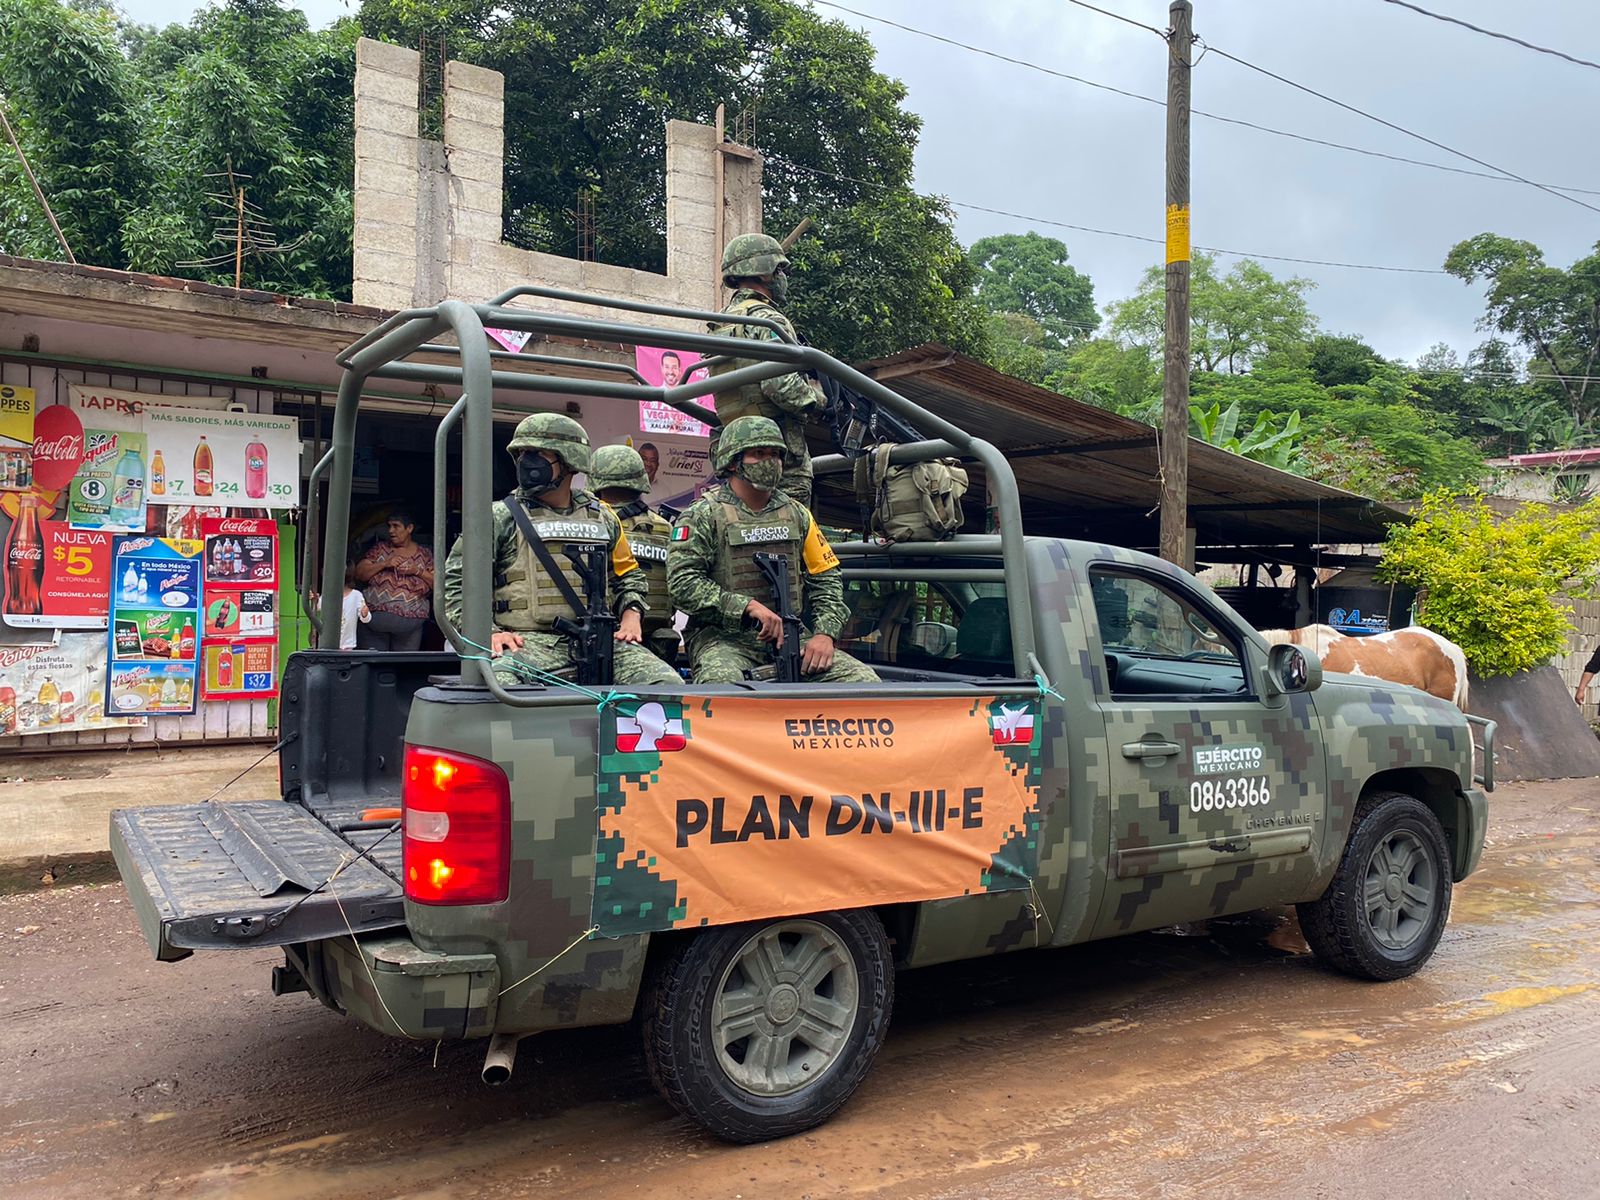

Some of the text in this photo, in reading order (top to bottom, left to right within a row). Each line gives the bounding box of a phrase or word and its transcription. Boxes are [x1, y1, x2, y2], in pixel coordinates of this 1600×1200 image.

[151, 413, 291, 430] MÁS SABORES, MÁS VARIEDAD
[647, 410, 670, 420] VEGA
[650, 423, 674, 431] XALAPA
[168, 480, 184, 491] $7
[215, 482, 239, 493] $24
[268, 484, 292, 495] $30
[219, 520, 259, 532] Coca-Cola
[538, 521, 599, 533] EJÉRCITO
[741, 526, 789, 537] EJÉRCITO
[54, 532, 107, 545] NUEVA
[745, 533, 789, 542] MEXICANO
[629, 541, 667, 560] ÉRCITO
[53, 545, 93, 575] $5
[254, 568, 272, 577] $20
[248, 674, 266, 687] $32
[785, 713, 895, 738] EJÉRCITO
[792, 737, 894, 750] MEXICANO
[1196, 747, 1263, 765] EJÉRCITO
[1199, 760, 1261, 773] MEXICANO
[1190, 776, 1271, 812] 0863366
[675, 787, 984, 848] PLAN DN-III-E
[1246, 813, 1312, 830] CHEYENNE
